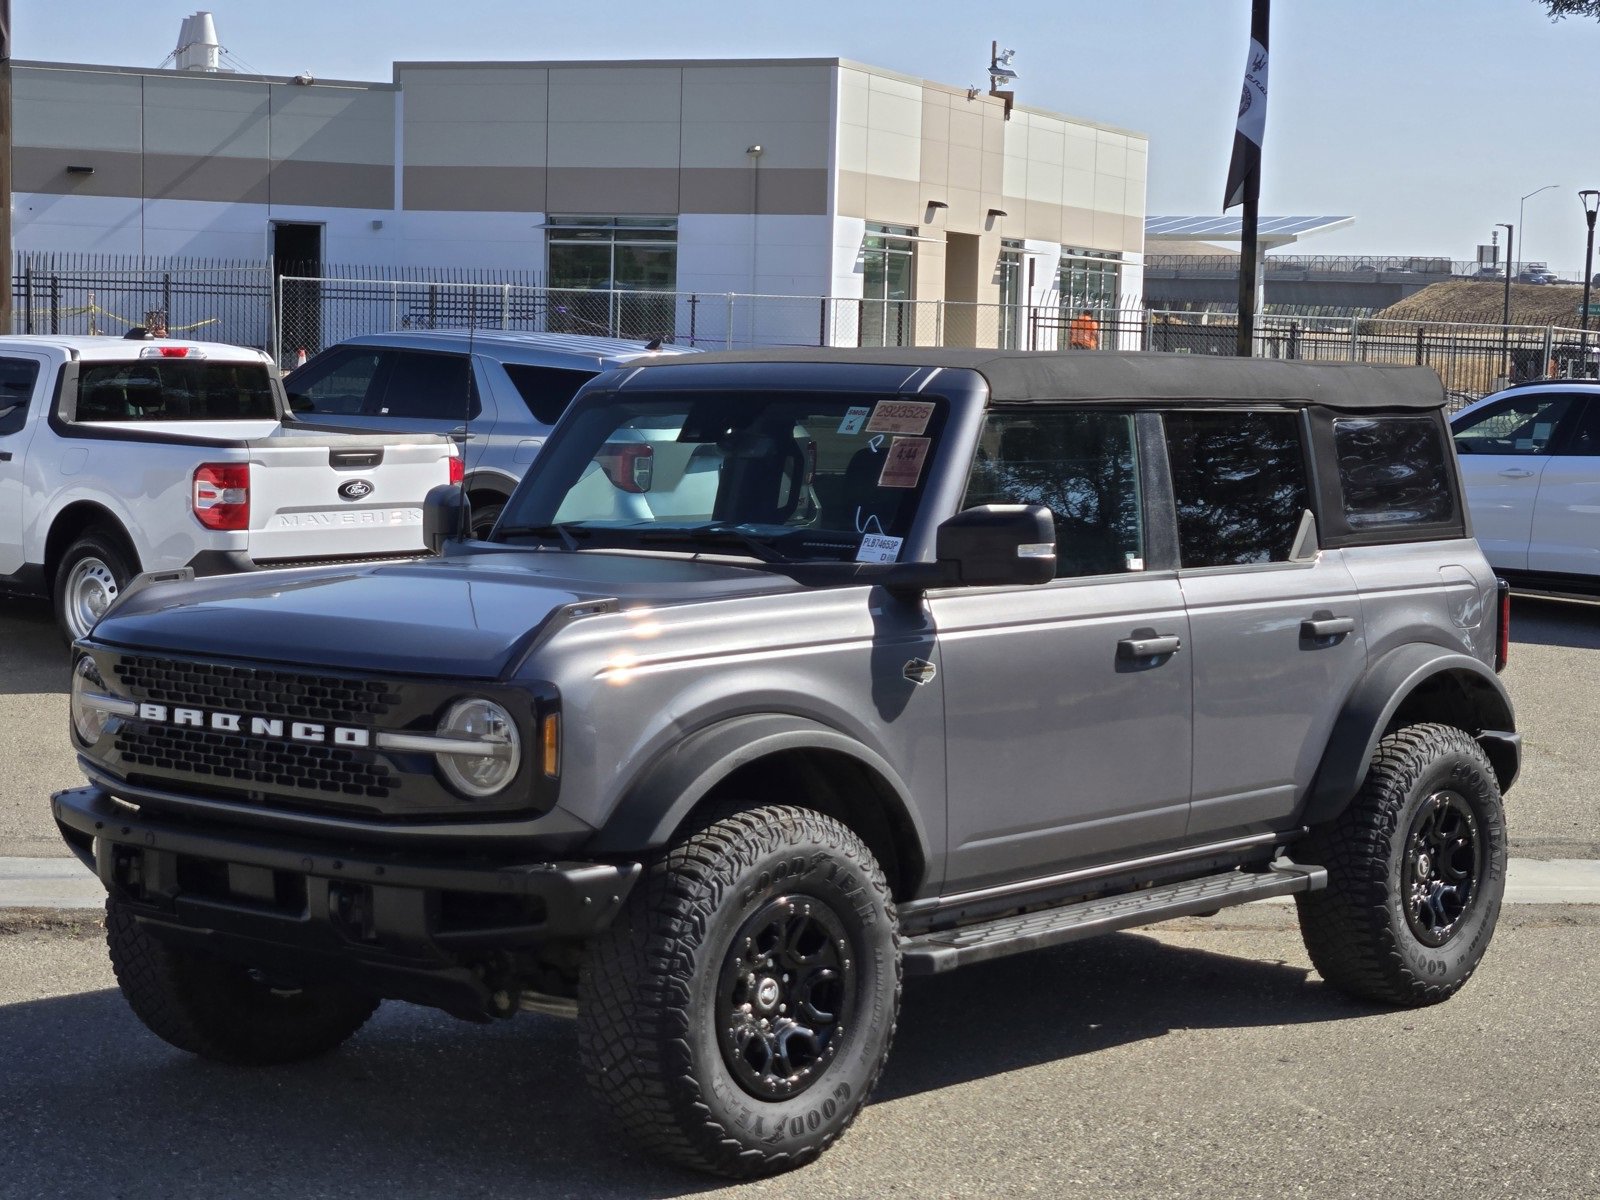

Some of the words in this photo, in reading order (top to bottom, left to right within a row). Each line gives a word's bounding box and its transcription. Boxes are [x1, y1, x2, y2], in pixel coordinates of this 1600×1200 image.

[280, 509, 422, 528] MAVERICK
[139, 702, 370, 747] BRONCO
[742, 851, 878, 928] GOODYEAR
[711, 1075, 851, 1146] GOODYEAR
